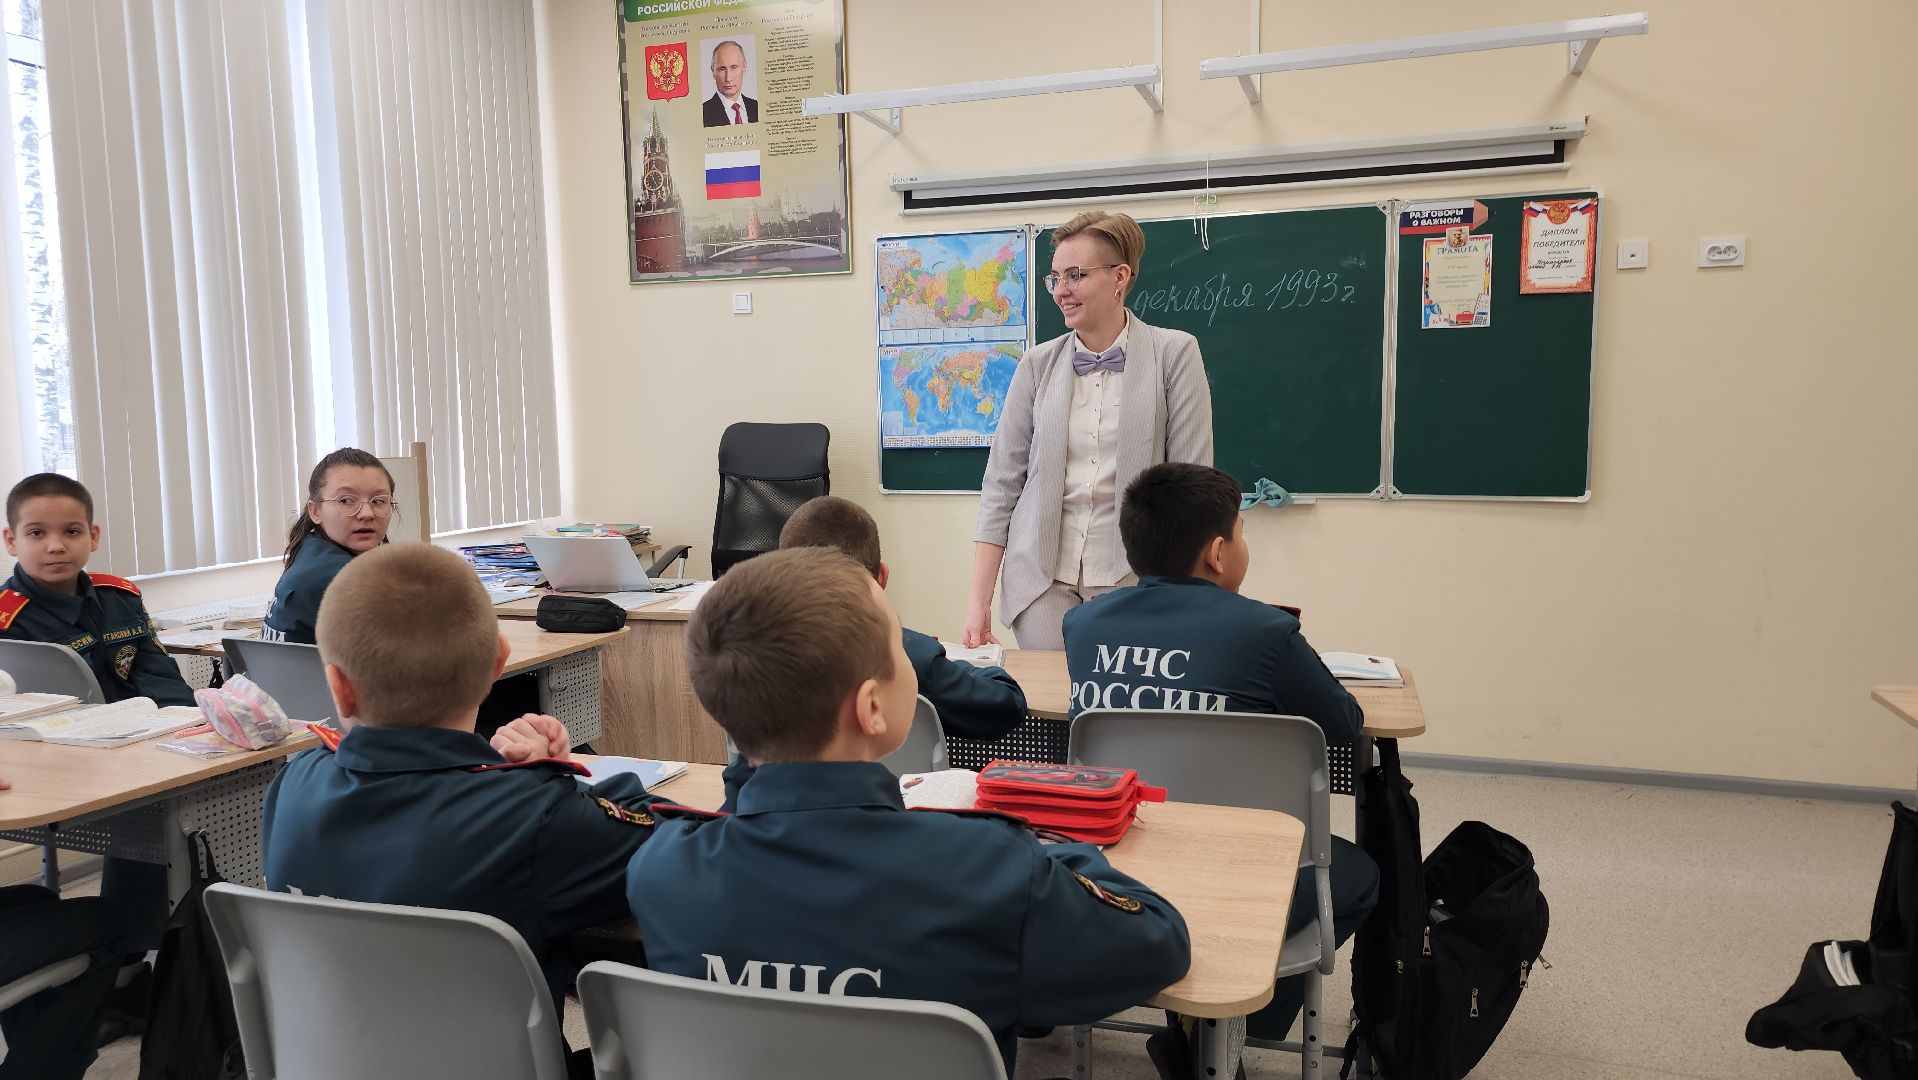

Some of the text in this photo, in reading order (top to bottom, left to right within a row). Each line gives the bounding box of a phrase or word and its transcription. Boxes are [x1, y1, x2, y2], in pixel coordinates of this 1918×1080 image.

[1409, 208, 1464, 220] РАЗГОВОРЫ
[1412, 216, 1461, 227] О ВАЖНОМ
[1540, 228, 1579, 238] ДИПЛОМ
[1532, 239, 1586, 249] ПОБЕДИТЕЛЯ
[1437, 245, 1479, 255] ГРАМОТА
[1133, 272, 1256, 328] декабря
[1092, 644, 1191, 680] МЧС
[1071, 680, 1230, 712] РОССИИ
